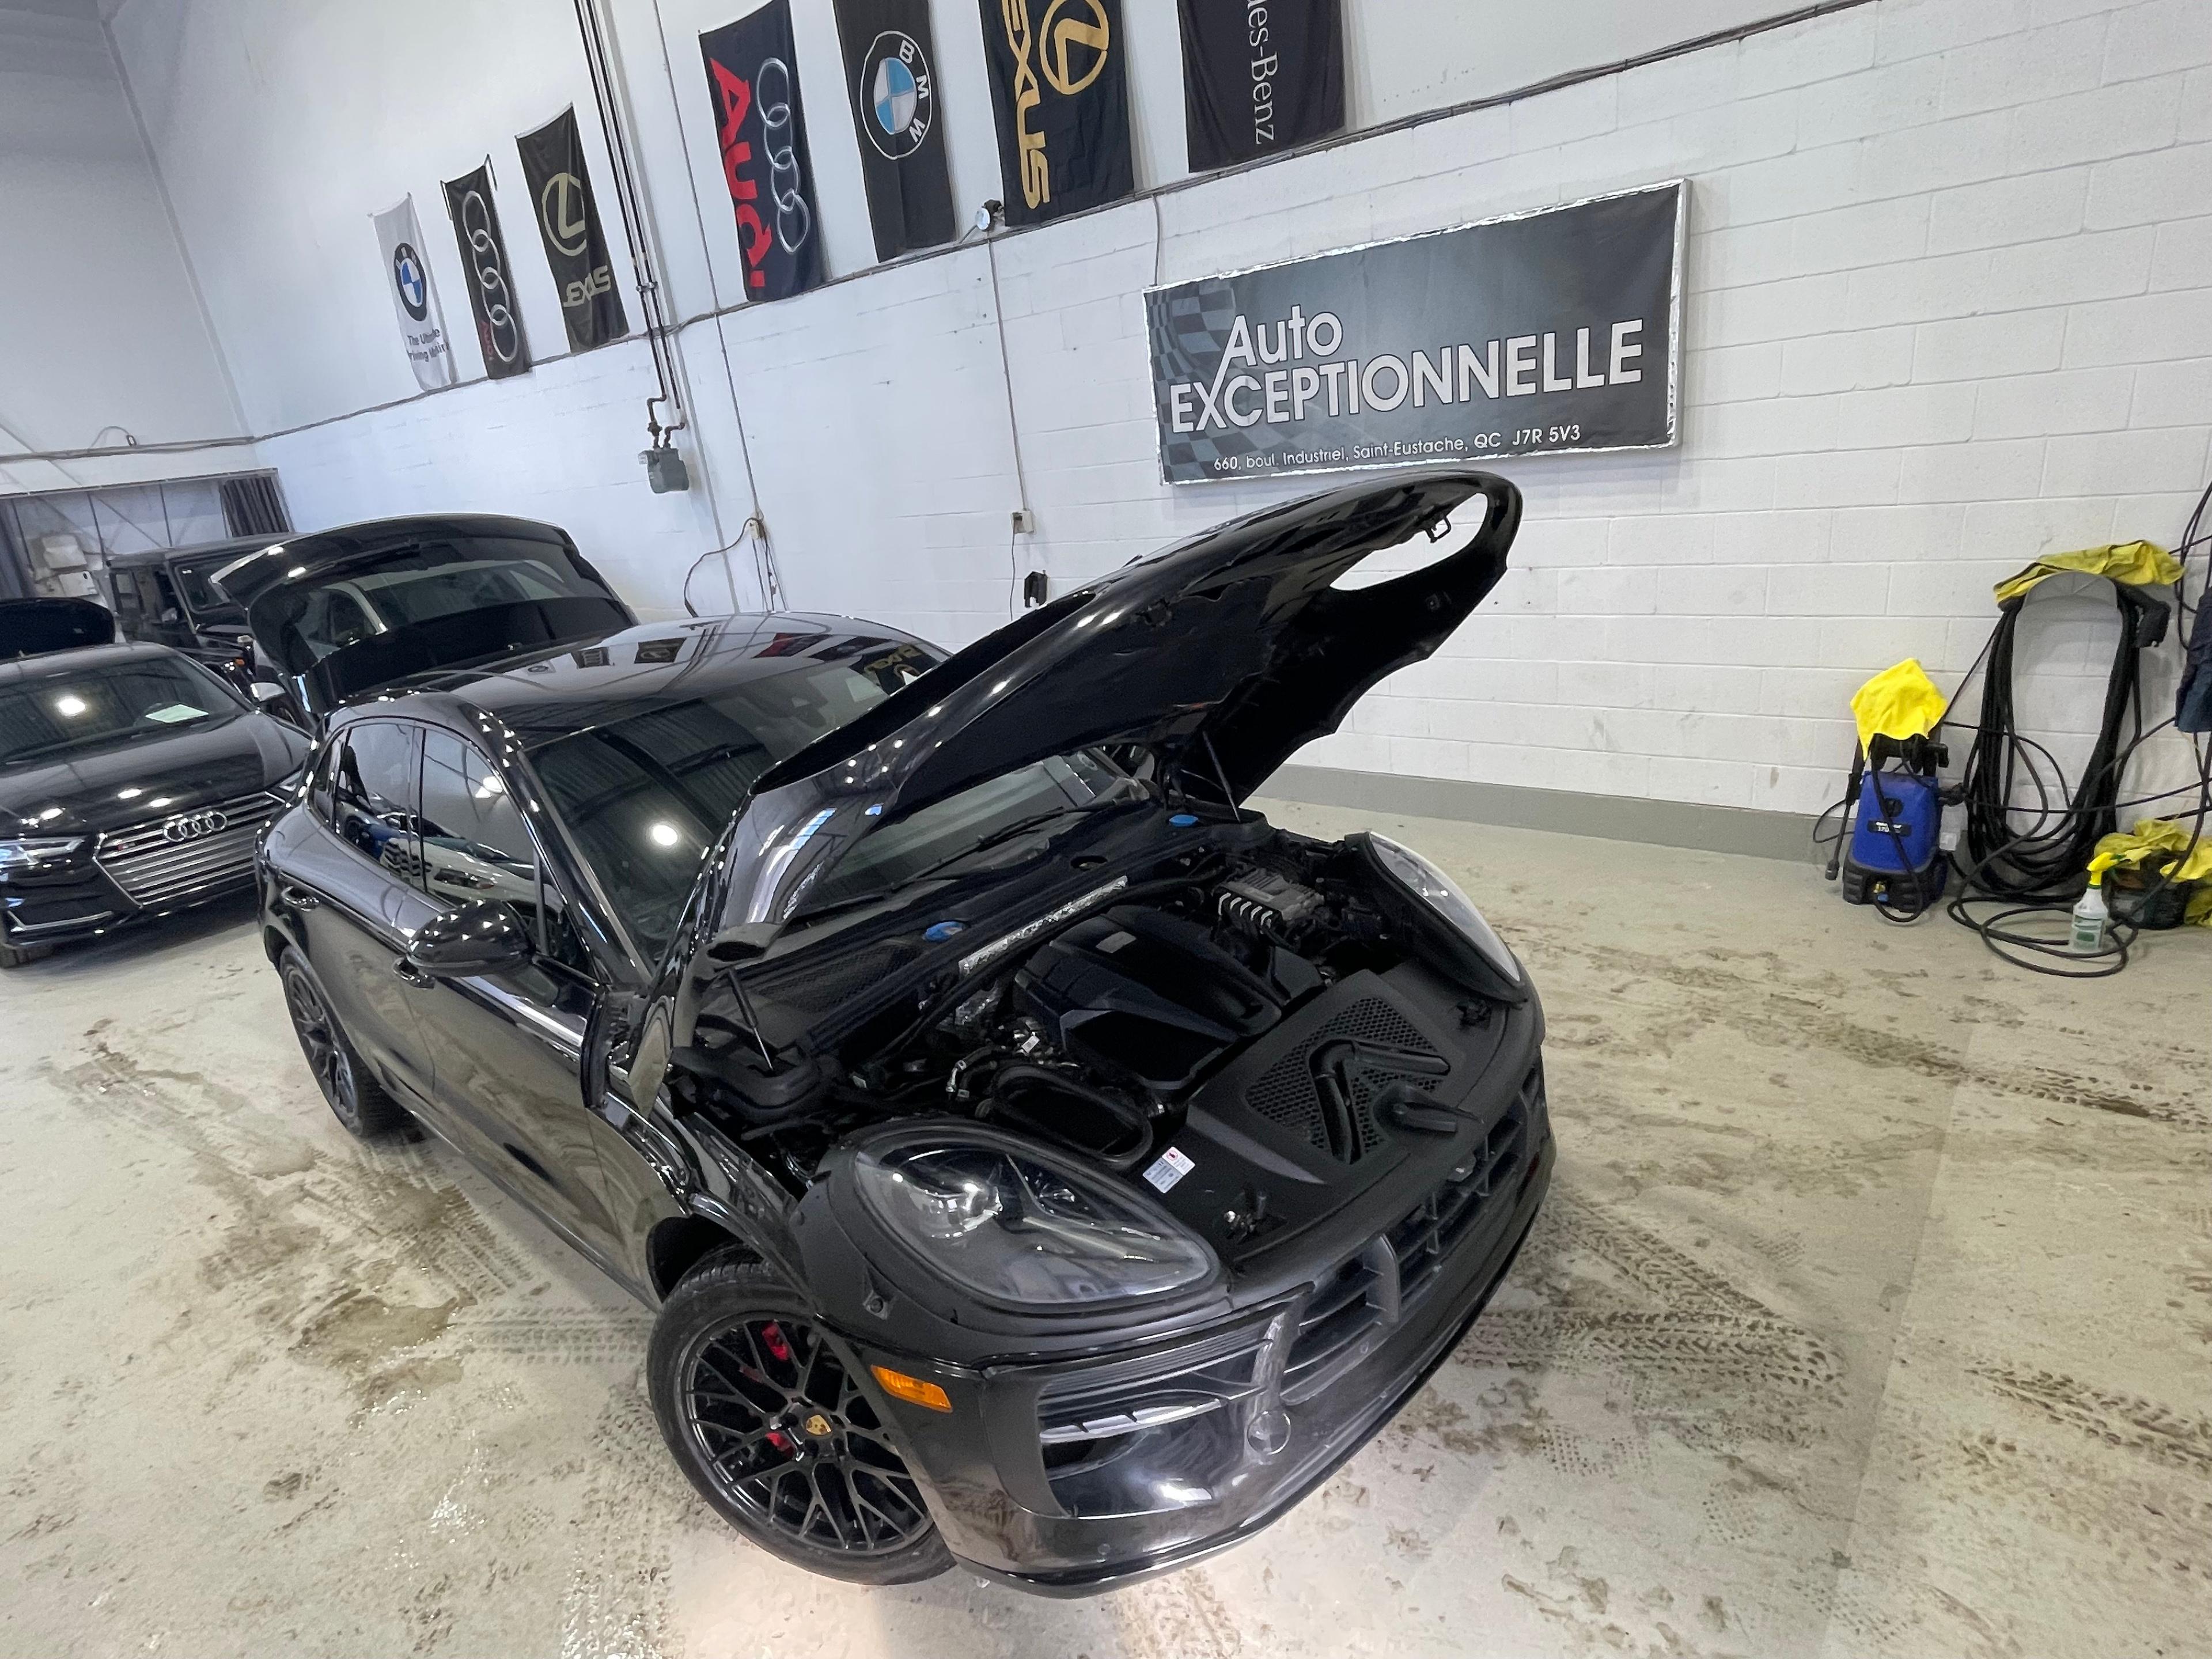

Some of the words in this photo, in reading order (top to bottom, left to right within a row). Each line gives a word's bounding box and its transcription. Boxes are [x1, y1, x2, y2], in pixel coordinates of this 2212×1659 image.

[899, 40, 929, 143] BMW
[1170, 318, 1643, 433] EXCEPTIONNELLE
[1220, 304, 1343, 369] Auto
[1213, 456, 1241, 471] 660,
[1245, 452, 1279, 468] boul.
[1282, 446, 1349, 465] Industriel,
[1353, 437, 1468, 460] Saint-Eustache,
[1474, 432, 1501, 449] QC
[1512, 428, 1543, 446] J7R
[1548, 424, 1581, 442] 5V3
